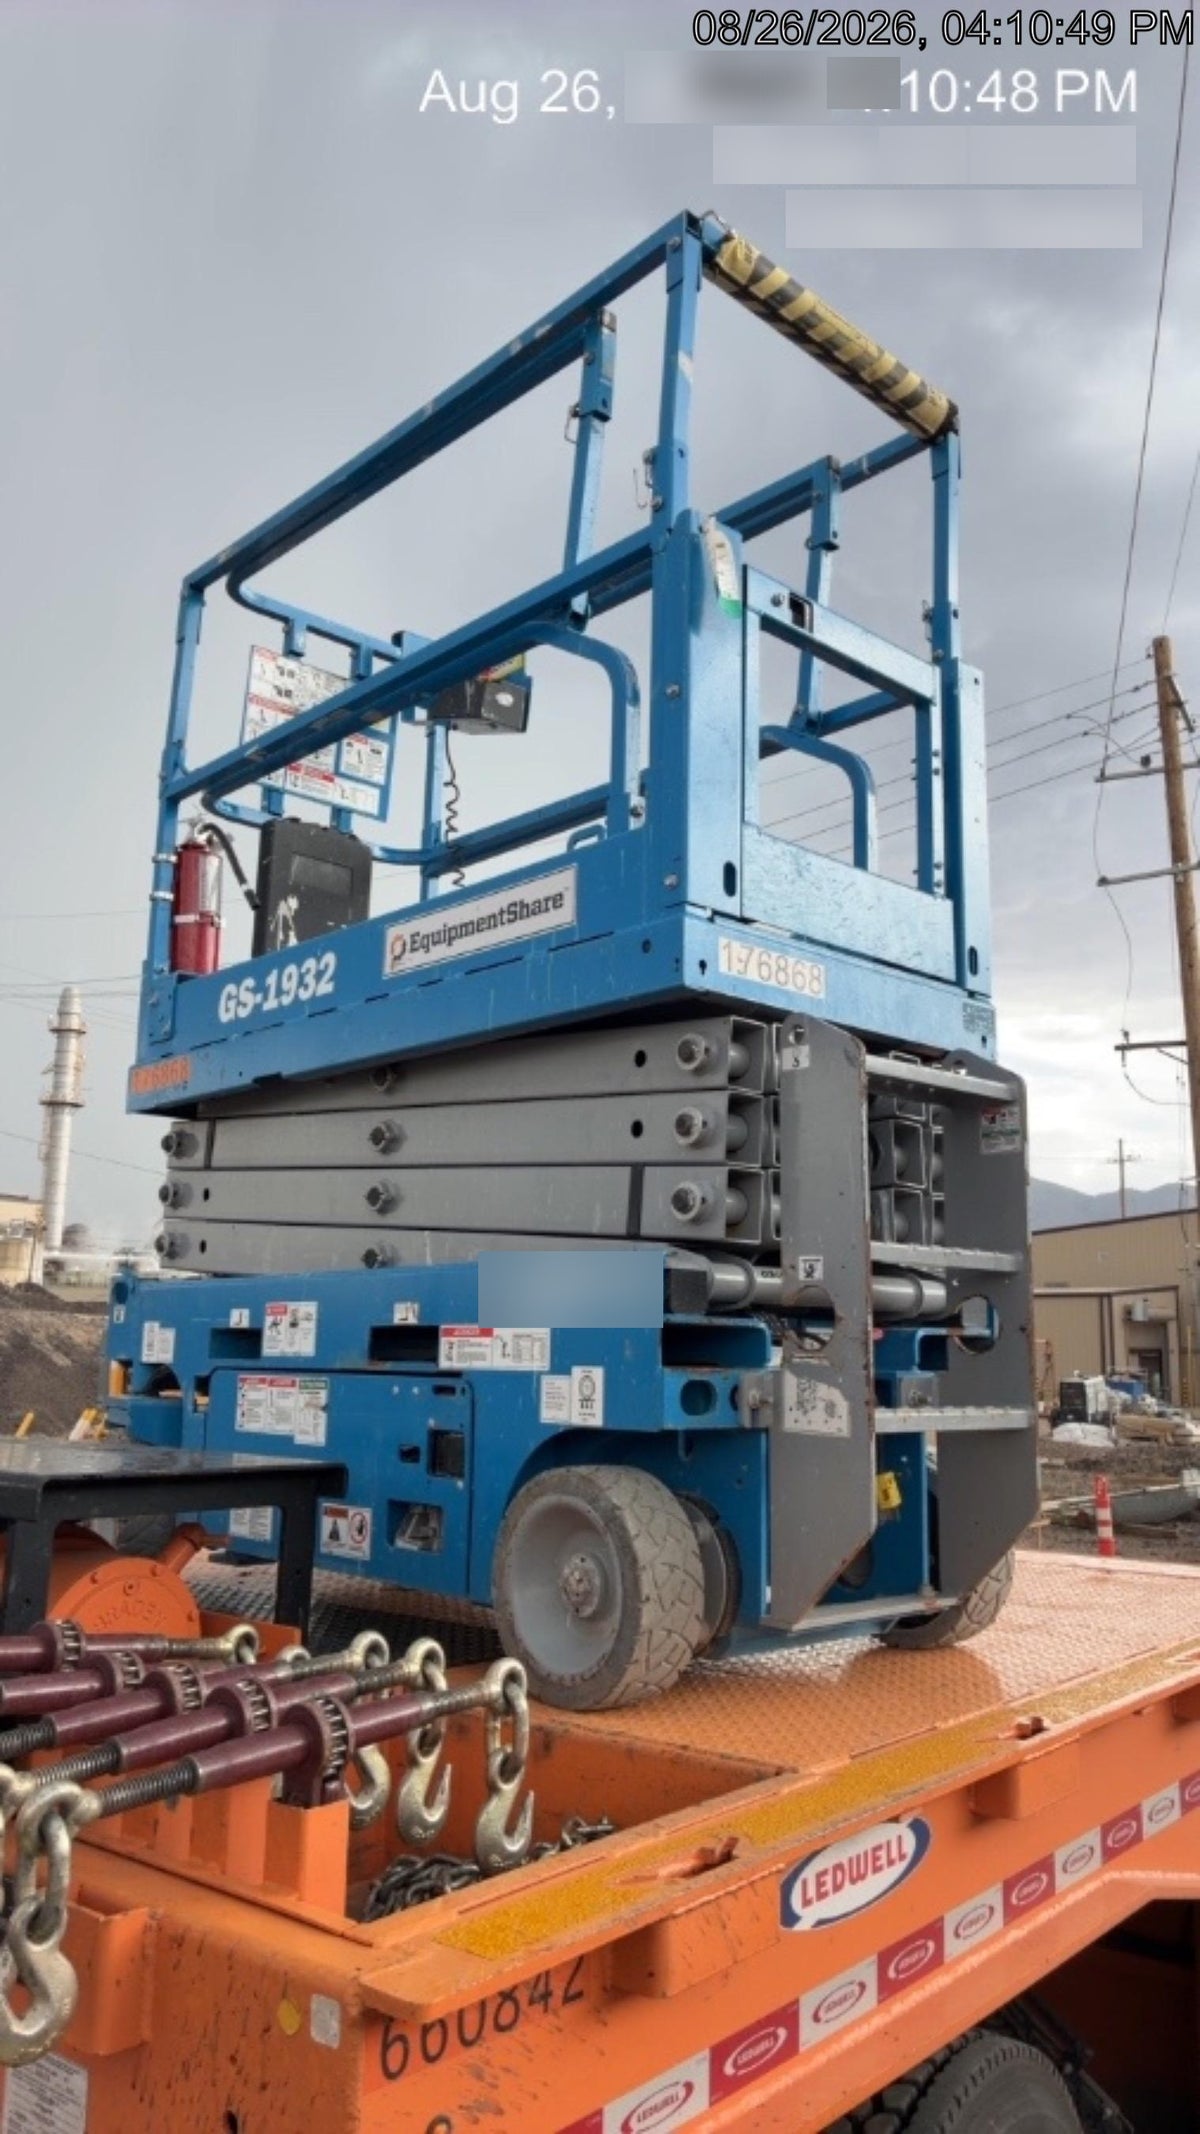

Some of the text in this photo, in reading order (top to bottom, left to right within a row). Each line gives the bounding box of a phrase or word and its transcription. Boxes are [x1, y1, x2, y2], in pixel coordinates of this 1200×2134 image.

[409, 891, 564, 954] EquipmentShare
[218, 951, 337, 1024] GS-1932
[801, 1834, 907, 1909] LEDWELL
